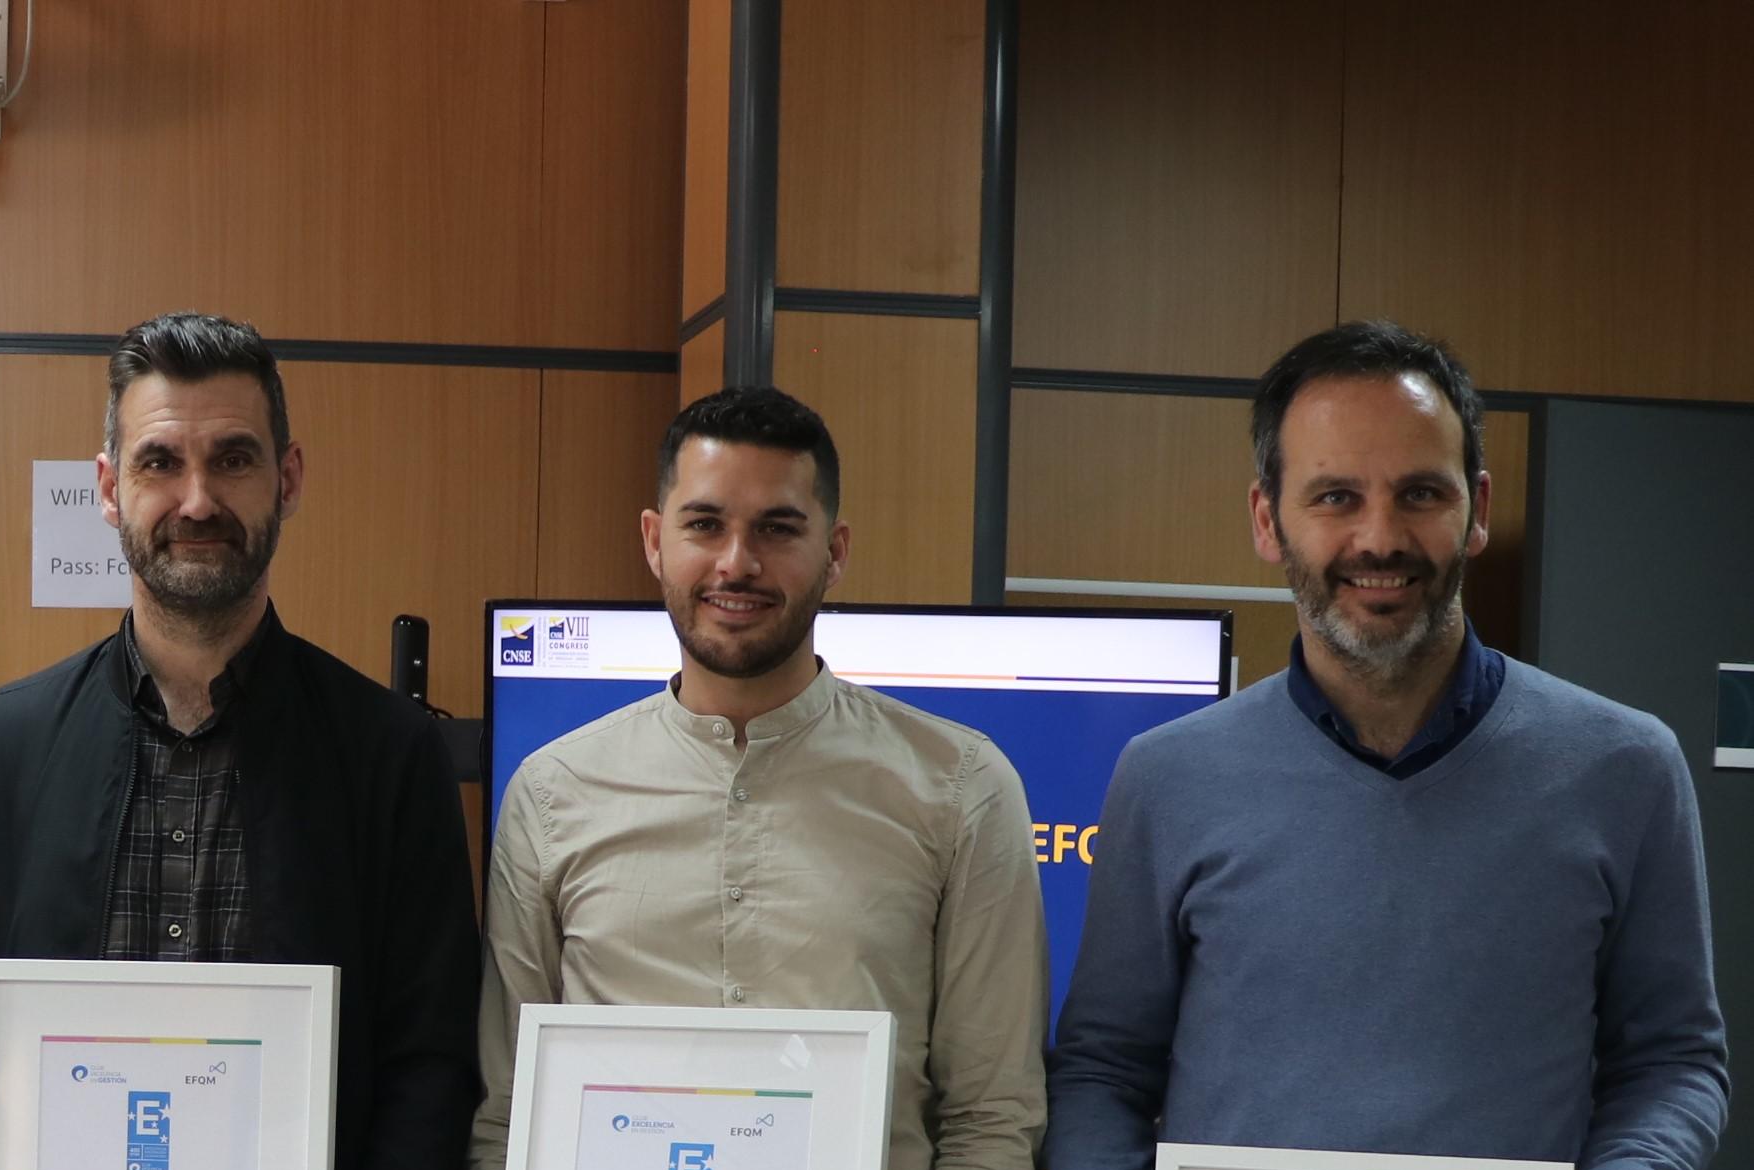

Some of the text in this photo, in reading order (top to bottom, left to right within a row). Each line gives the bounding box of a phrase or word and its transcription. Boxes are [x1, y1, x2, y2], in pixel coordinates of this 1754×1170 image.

[51, 557, 99, 574] Pass:
[566, 617, 589, 637] VIII
[503, 650, 531, 663] CNSE
[185, 1075, 216, 1085] EFQM
[730, 1128, 762, 1137] EFQM
